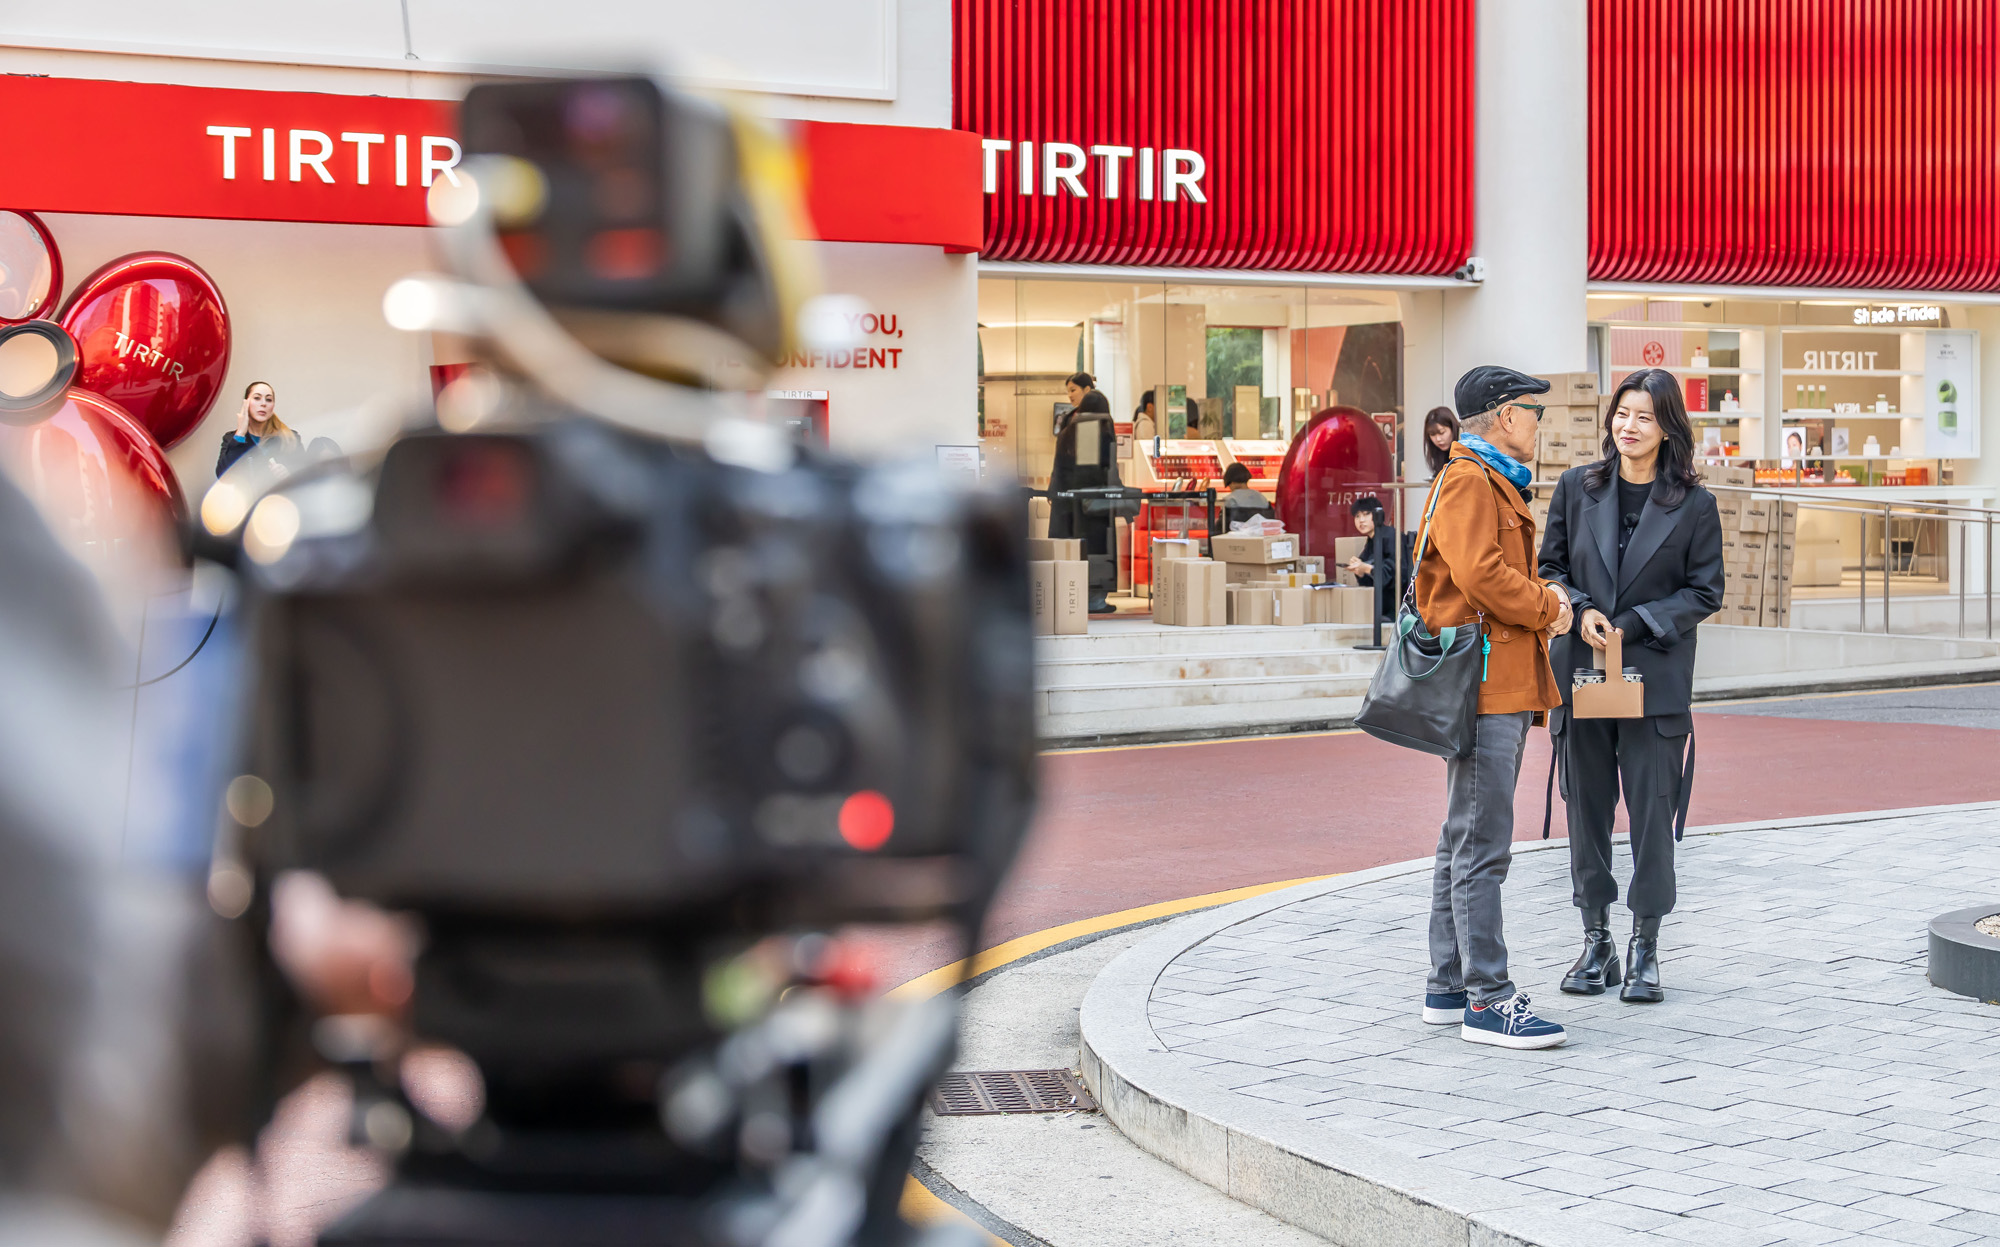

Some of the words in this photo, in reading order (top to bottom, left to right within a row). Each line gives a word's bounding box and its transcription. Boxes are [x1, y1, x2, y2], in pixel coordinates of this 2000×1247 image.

[206, 125, 463, 188] TIRTIR
[982, 138, 1207, 204] TIRTIR
[1853, 306, 1896, 325] Shade
[1897, 305, 1940, 322] Finder
[115, 331, 185, 381] TIRTIR
[782, 390, 813, 398] TIRTIR
[1035, 580, 1043, 615] TIRTIR
